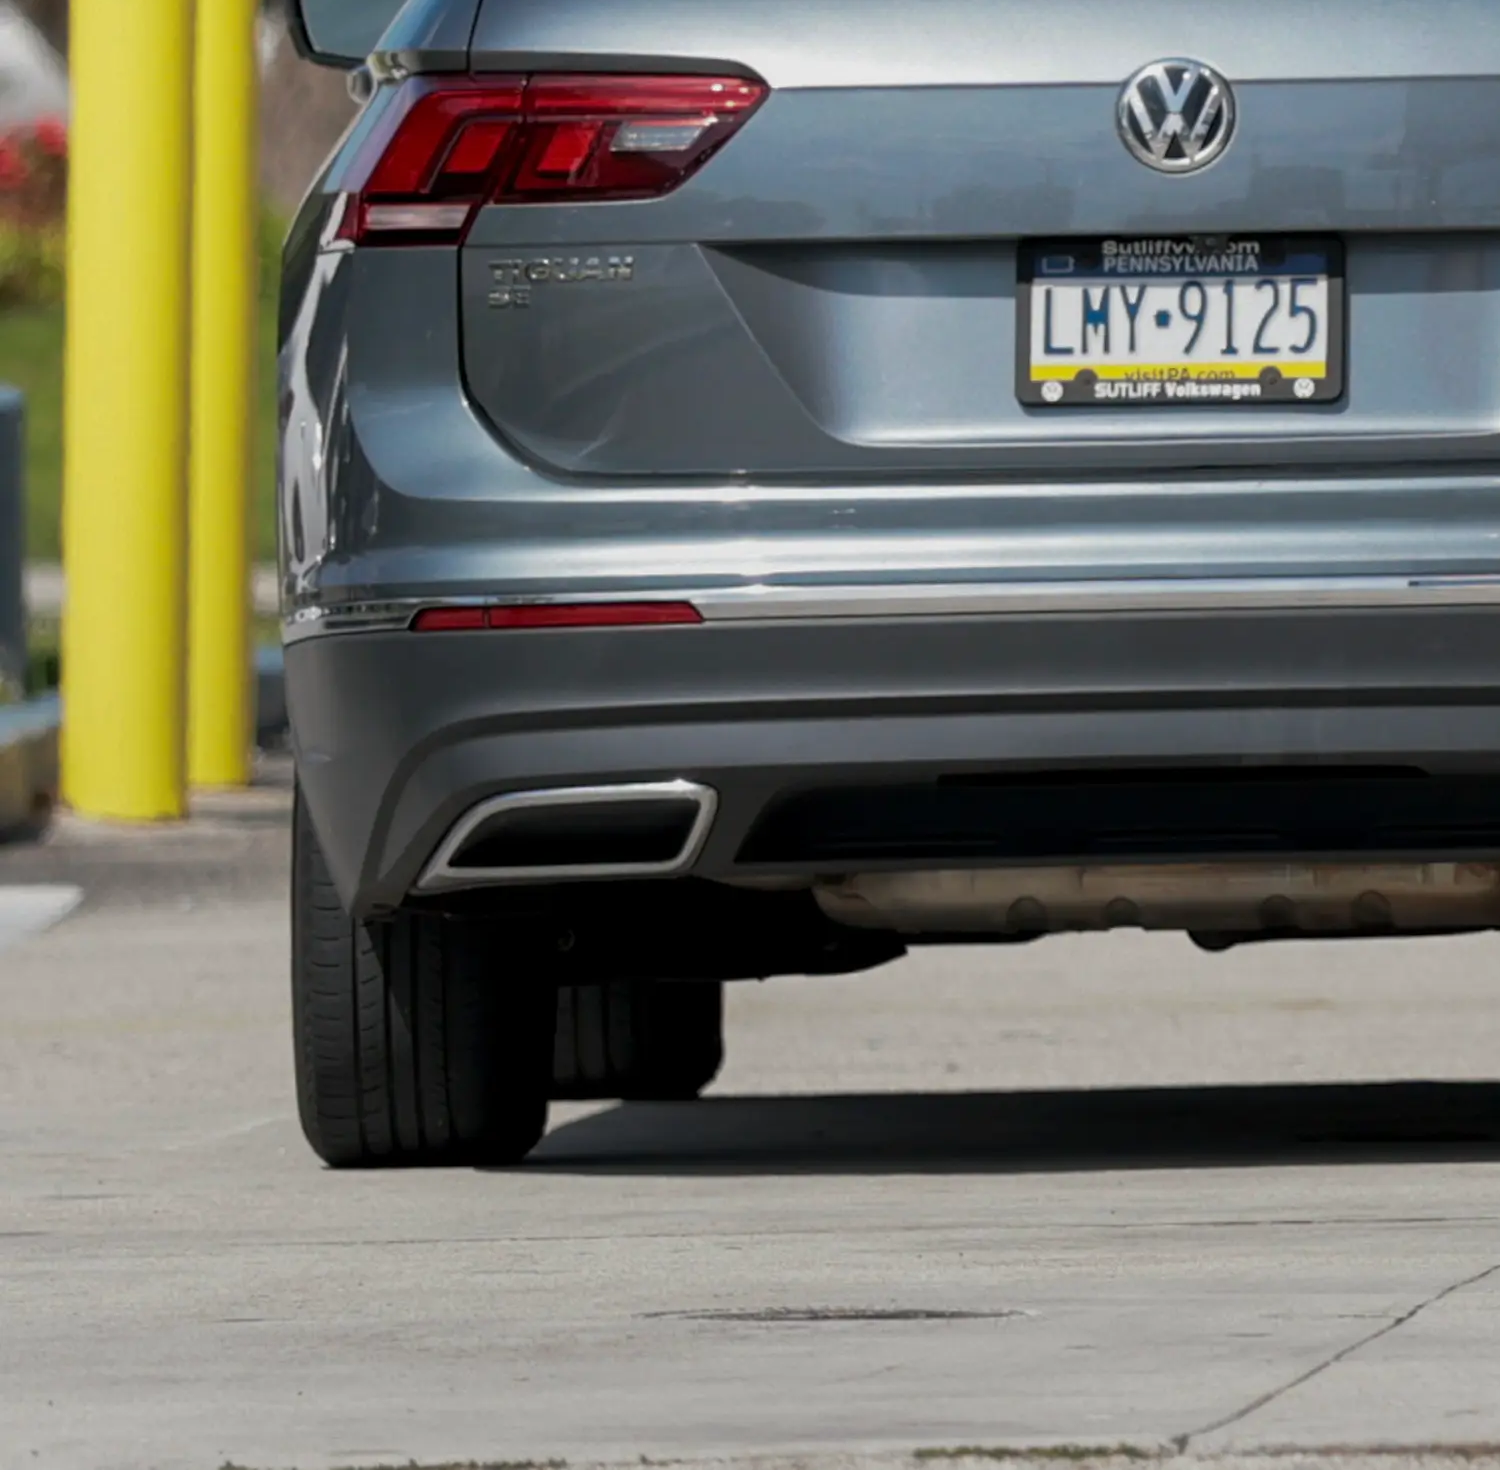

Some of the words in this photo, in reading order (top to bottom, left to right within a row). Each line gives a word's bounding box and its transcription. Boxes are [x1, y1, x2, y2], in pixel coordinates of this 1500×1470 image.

[1102, 254, 1260, 274] PENNSYLVANIA
[1094, 381, 1162, 399] SUTLIFF
[1164, 381, 1262, 401] Volkswagen
